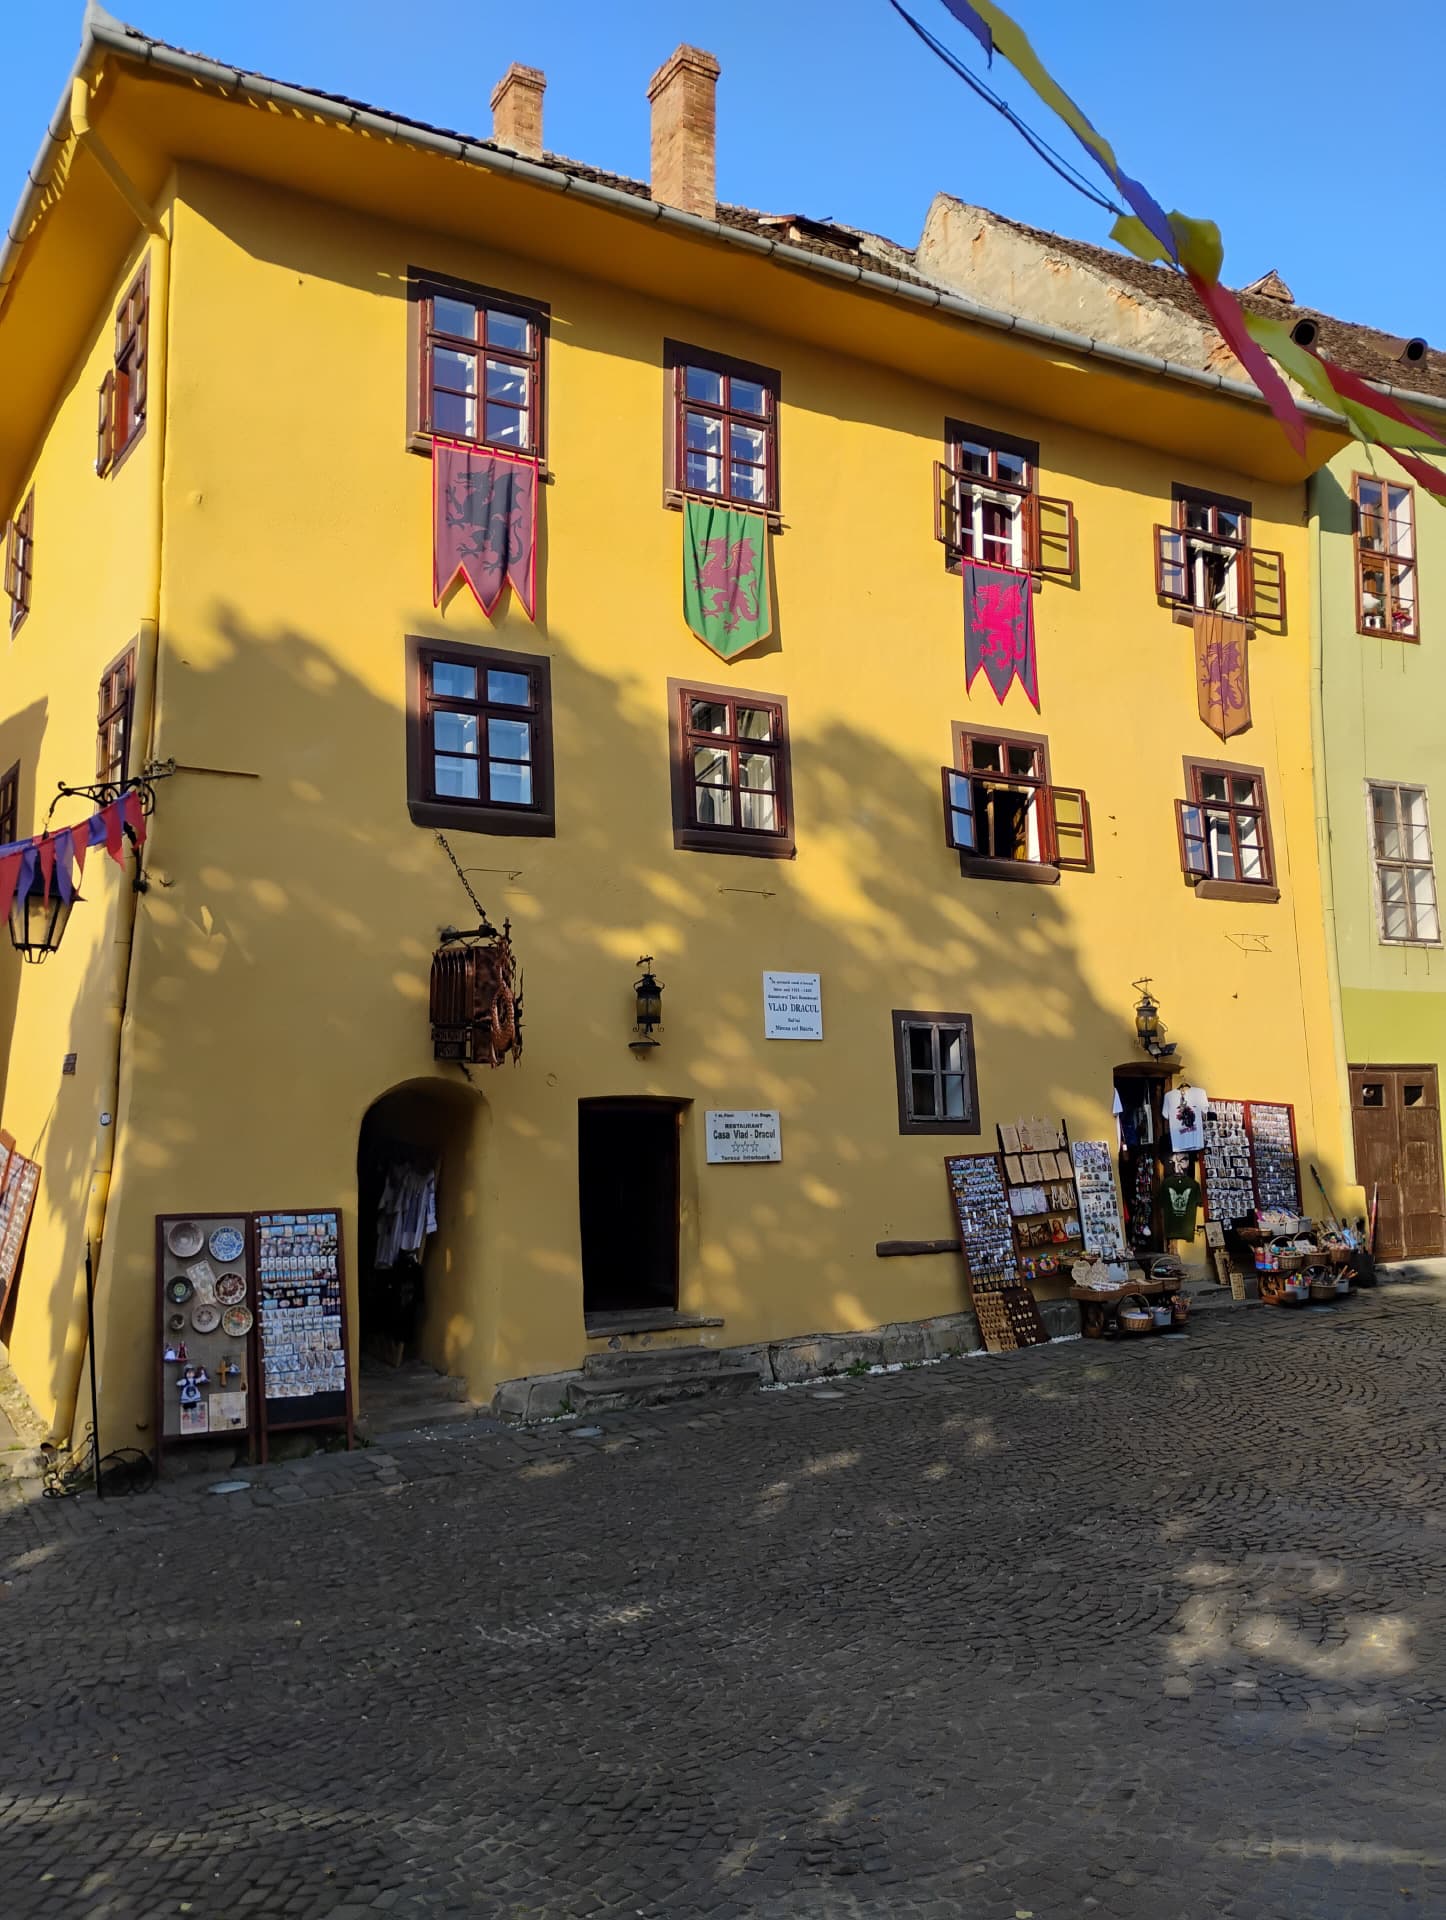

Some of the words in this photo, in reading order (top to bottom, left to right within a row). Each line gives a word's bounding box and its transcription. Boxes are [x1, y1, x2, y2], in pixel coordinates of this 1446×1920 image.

[768, 1002, 787, 1012] VLAD
[790, 1003, 819, 1013] DRACUL
[713, 1129, 730, 1139] Casa
[733, 1129, 748, 1139] Vlad
[754, 1129, 775, 1138] Dracul
